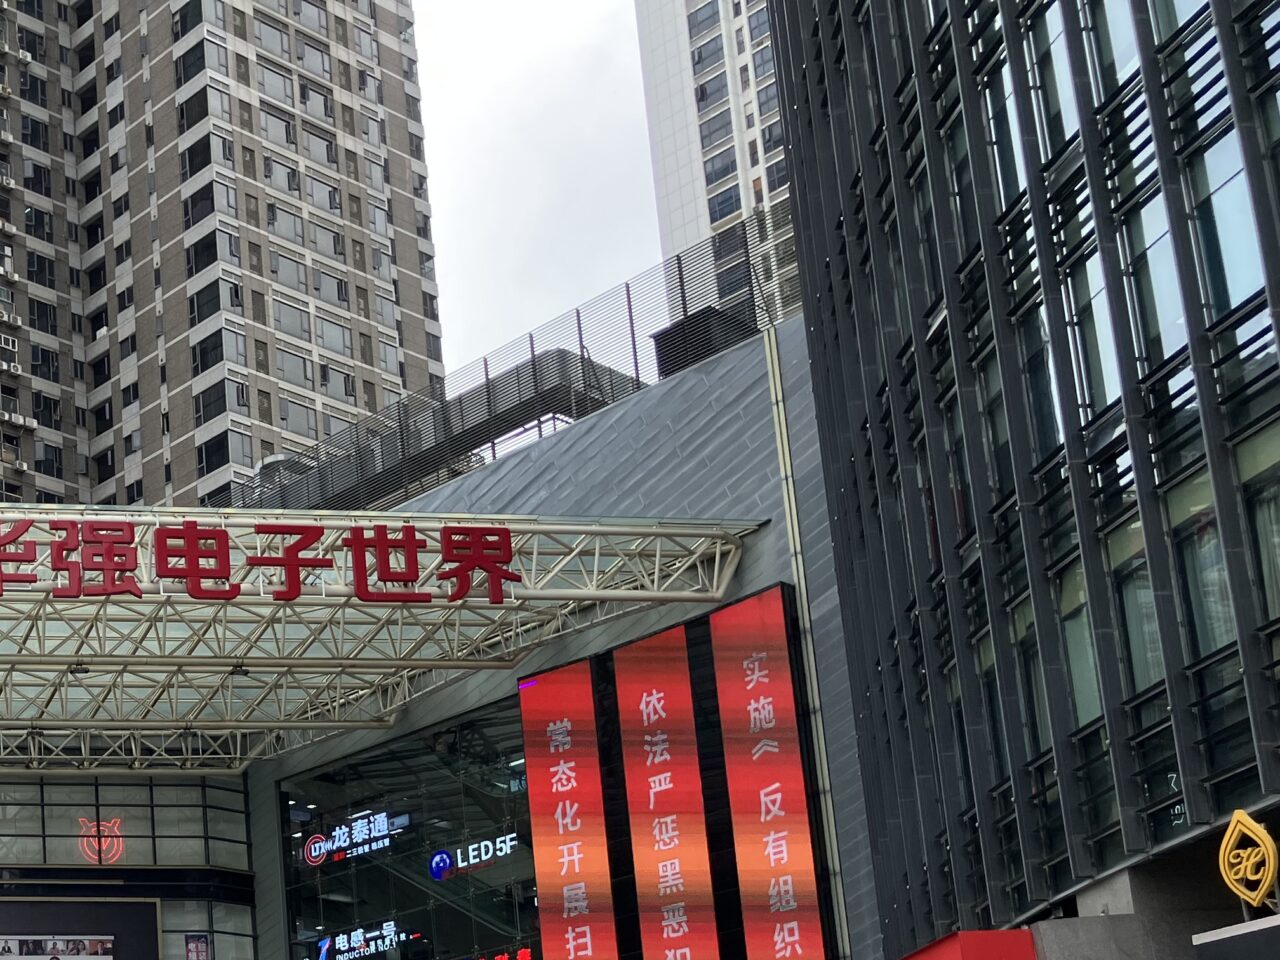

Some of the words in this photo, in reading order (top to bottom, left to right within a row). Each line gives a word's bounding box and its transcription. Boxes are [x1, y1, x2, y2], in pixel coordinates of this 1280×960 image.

[332, 812, 389, 849] 龙泰通
[456, 841, 494, 868] LED
[495, 834, 518, 857] 5F
[335, 920, 397, 951] 电感一号
